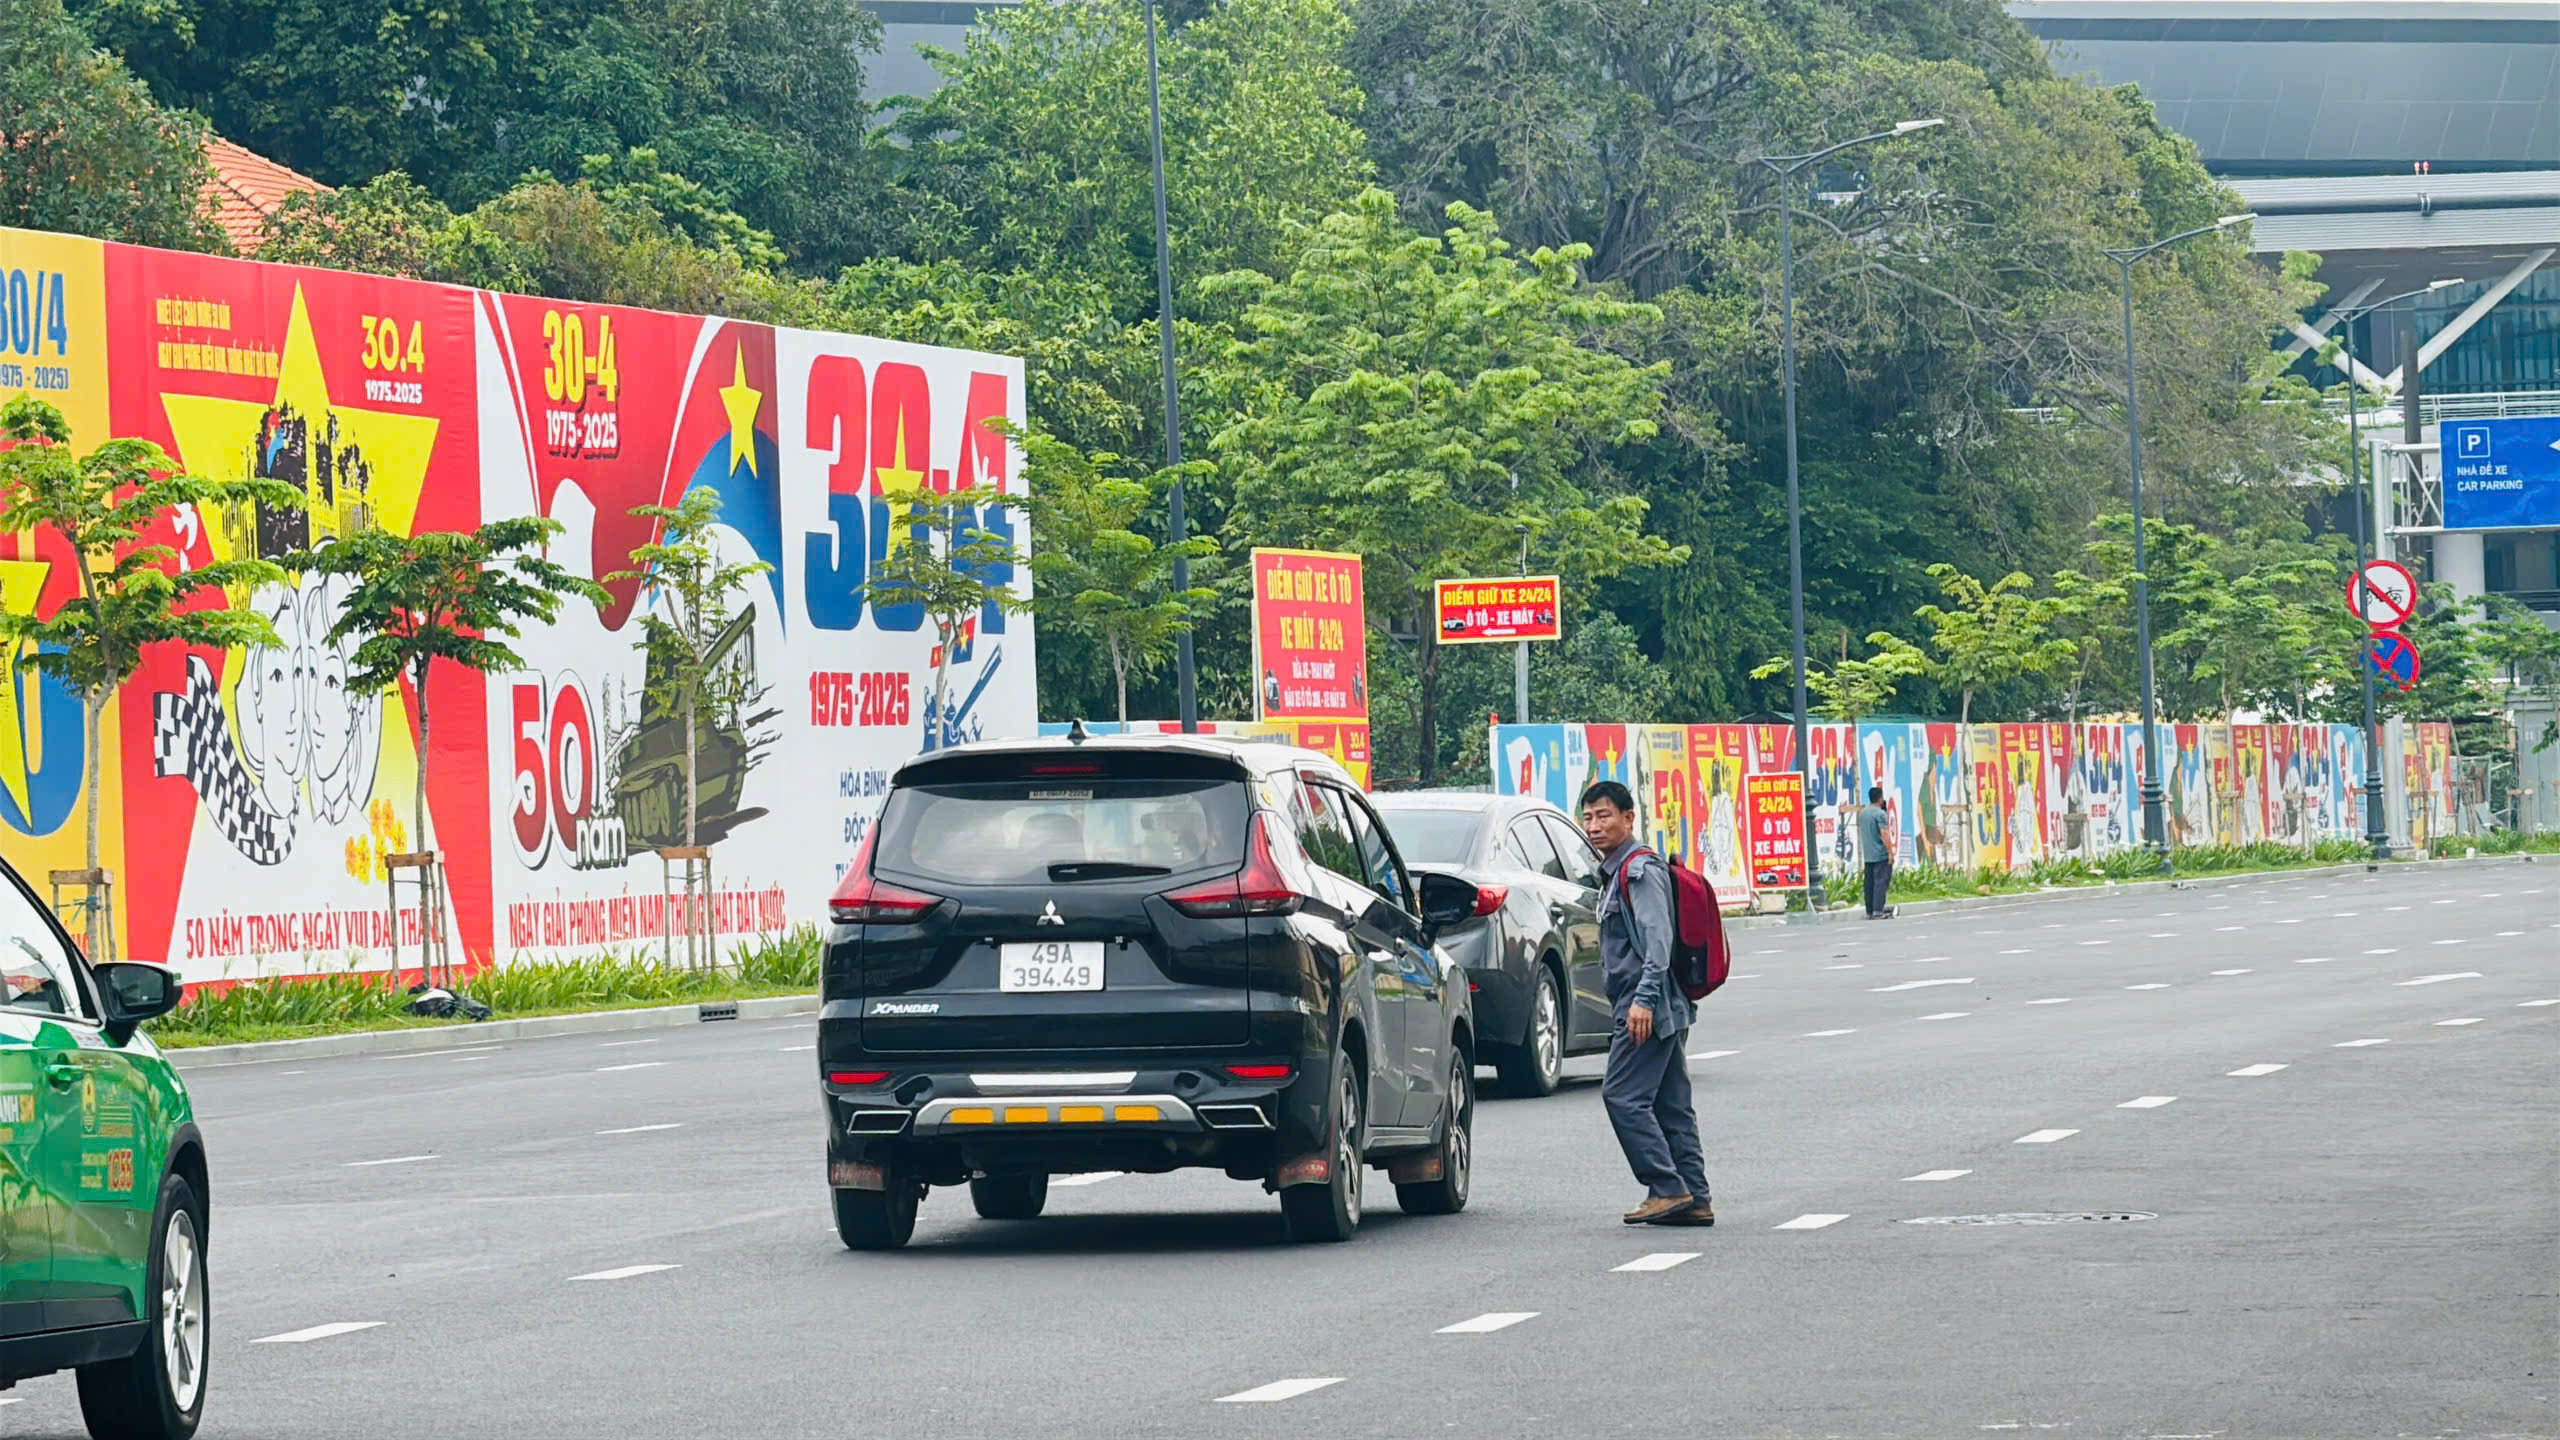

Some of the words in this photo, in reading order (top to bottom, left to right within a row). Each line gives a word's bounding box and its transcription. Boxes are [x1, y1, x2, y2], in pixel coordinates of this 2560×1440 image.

[361, 315, 424, 373] 30.4
[543, 310, 617, 403] 30-4
[0, 364, 23, 388] 975
[365, 379, 423, 404] 1975.2025
[545, 409, 618, 448] 1975-2025
[2467, 434, 2481, 451] P
[2456, 463, 2477, 476] NHÀ
[2479, 460, 2493, 476] ĐỂ
[2495, 465, 2508, 475] XE
[805, 354, 1014, 635] 30-4
[2457, 480, 2479, 492] CAR
[2480, 479, 2523, 491] PARKING
[1267, 556, 1294, 601] ĐIỂM
[1295, 565, 1312, 601] GIỮ
[1314, 572, 1328, 603] XE
[1329, 566, 1338, 604] Ô
[1338, 568, 1353, 605] TÔ
[1444, 584, 1474, 606] ĐIỂM
[1477, 586, 1498, 605] GIỮ
[1501, 588, 1516, 604] XE
[1519, 587, 1552, 603] 24/24
[1466, 608, 1474, 627] Ô
[1475, 608, 1488, 626] TÔ
[1496, 610, 1510, 626] XE
[1512, 607, 1534, 625] MÁY
[1280, 616, 1294, 649] XE
[1294, 610, 1315, 650] MÁY
[1318, 618, 1345, 651] 24/24
[809, 671, 910, 727] 1975-2025
[509, 672, 597, 866] 50
[575, 803, 627, 869] năm
[1812, 727, 1856, 806] 30-4
[840, 767, 861, 798] HÒA
[863, 766, 887, 797] BÌNH
[1750, 777, 1771, 793] ĐIỂM
[1773, 778, 1787, 792] GIỮ
[1790, 779, 1800, 792] XE
[1759, 796, 1793, 813] 24/24
[844, 811, 865, 847] ĐỘC
[1763, 817, 1772, 835] Ô
[1775, 817, 1790, 835] TÔ
[1755, 840, 1771, 856] XE
[1774, 838, 1801, 855] MÁY
[508, 893, 540, 949] NGÀY
[543, 886, 567, 947] GIẢI
[569, 891, 606, 946] PHÓNG
[608, 881, 637, 942] MIỀN
[640, 894, 664, 938] NAM
[669, 884, 705, 937] THỐG
[708, 876, 734, 935] HẤT
[736, 876, 756, 933] ĐẤT
[758, 880, 786, 932] NƯỚC
[186, 917, 205, 960] 50
[208, 908, 243, 957] NĂM
[247, 913, 298, 955] TRONG
[302, 902, 341, 951] NGÀY
[344, 910, 368, 950] VUI
[373, 910, 397, 957] ĐẠ
[1031, 944, 1073, 964] 49A
[1013, 967, 1091, 988] 394.49
[870, 1002, 940, 1015] XPANDER
